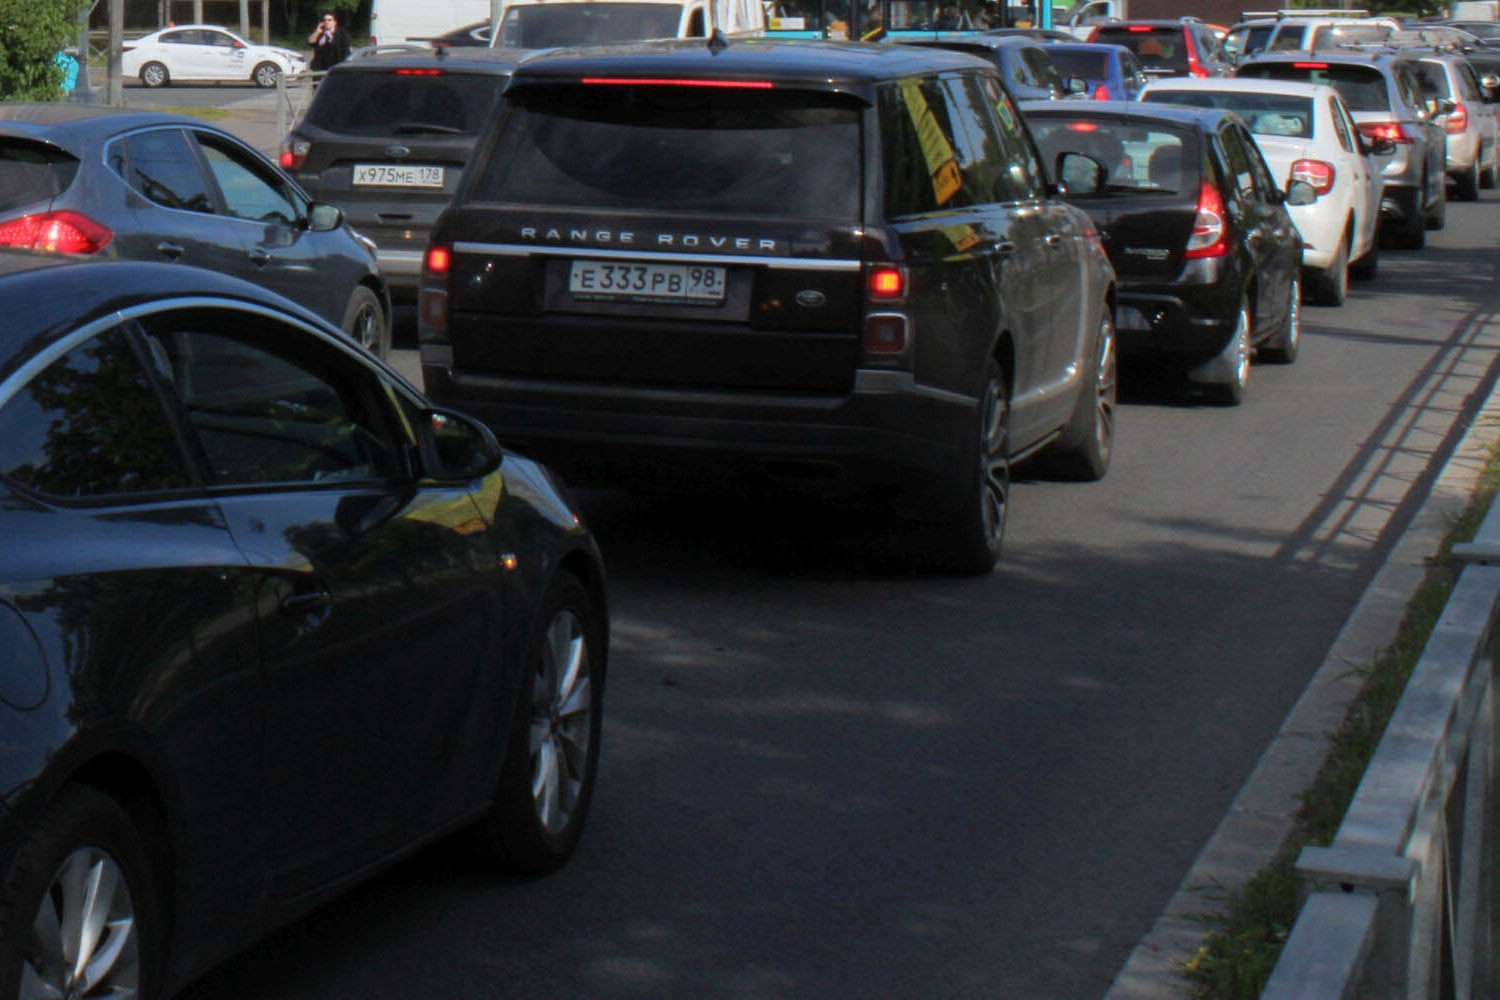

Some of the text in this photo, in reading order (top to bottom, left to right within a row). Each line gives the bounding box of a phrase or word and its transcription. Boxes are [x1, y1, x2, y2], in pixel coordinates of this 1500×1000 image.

[521, 226, 776, 250] RANGE ROVER
[580, 264, 715, 293] Е333РВ 98
